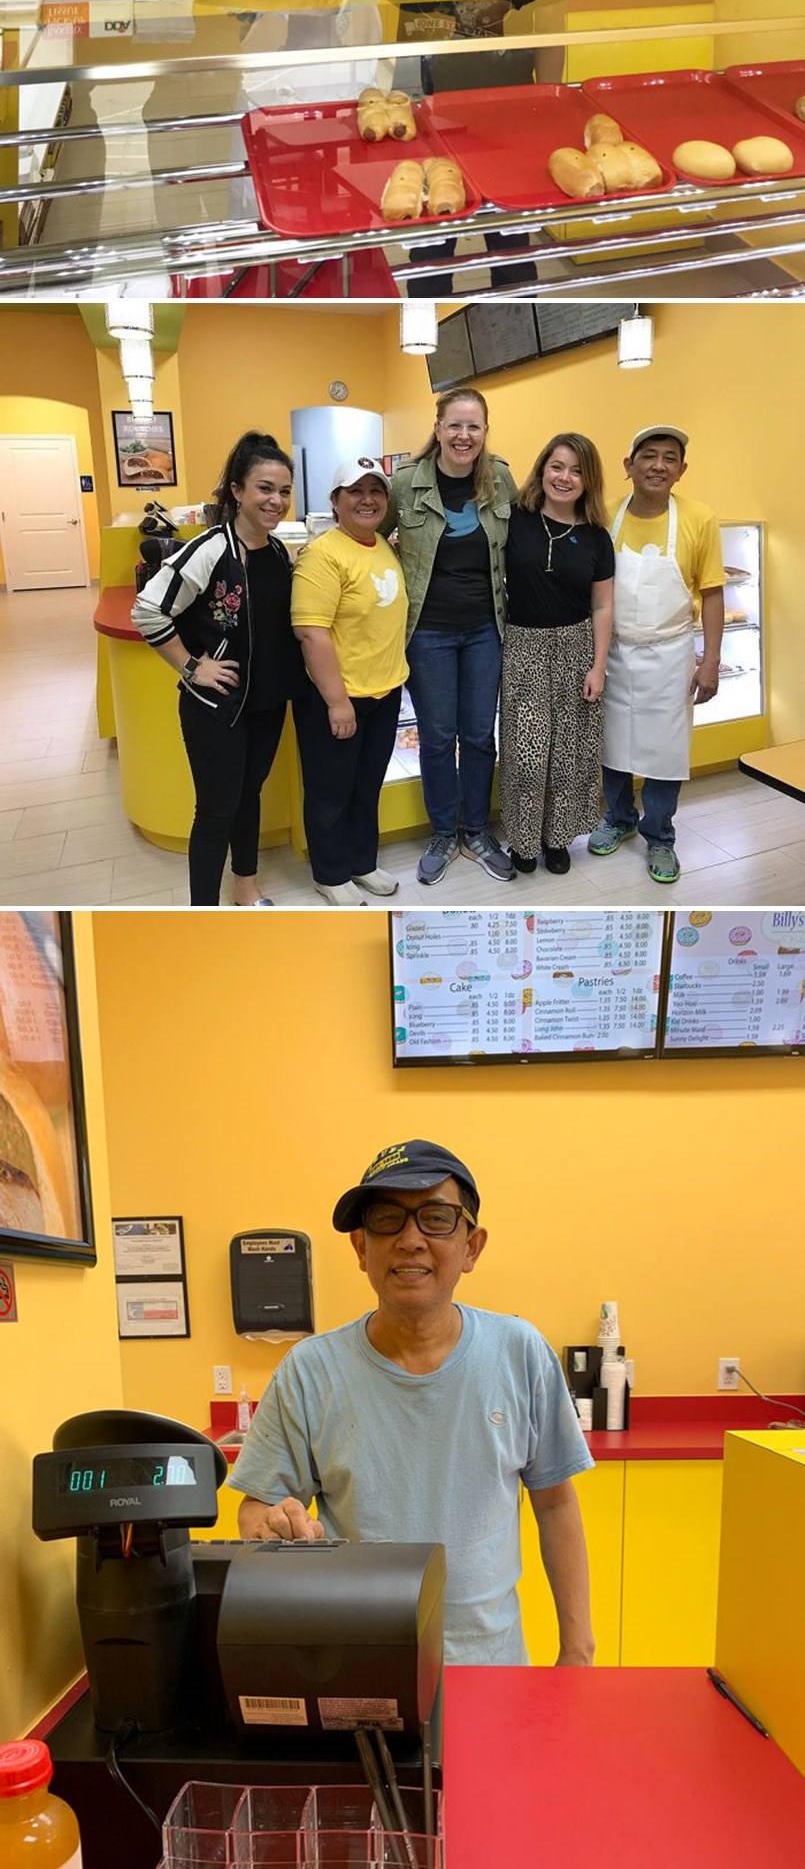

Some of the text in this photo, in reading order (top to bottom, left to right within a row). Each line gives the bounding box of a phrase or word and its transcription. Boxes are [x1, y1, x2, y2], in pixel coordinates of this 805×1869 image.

[773, 912, 804, 930] Billy's
[579, 977, 614, 987] Pastries
[450, 983, 472, 992] Cake
[70, 1470, 106, 1491] 001
[110, 1497, 141, 1507] ROYAL
